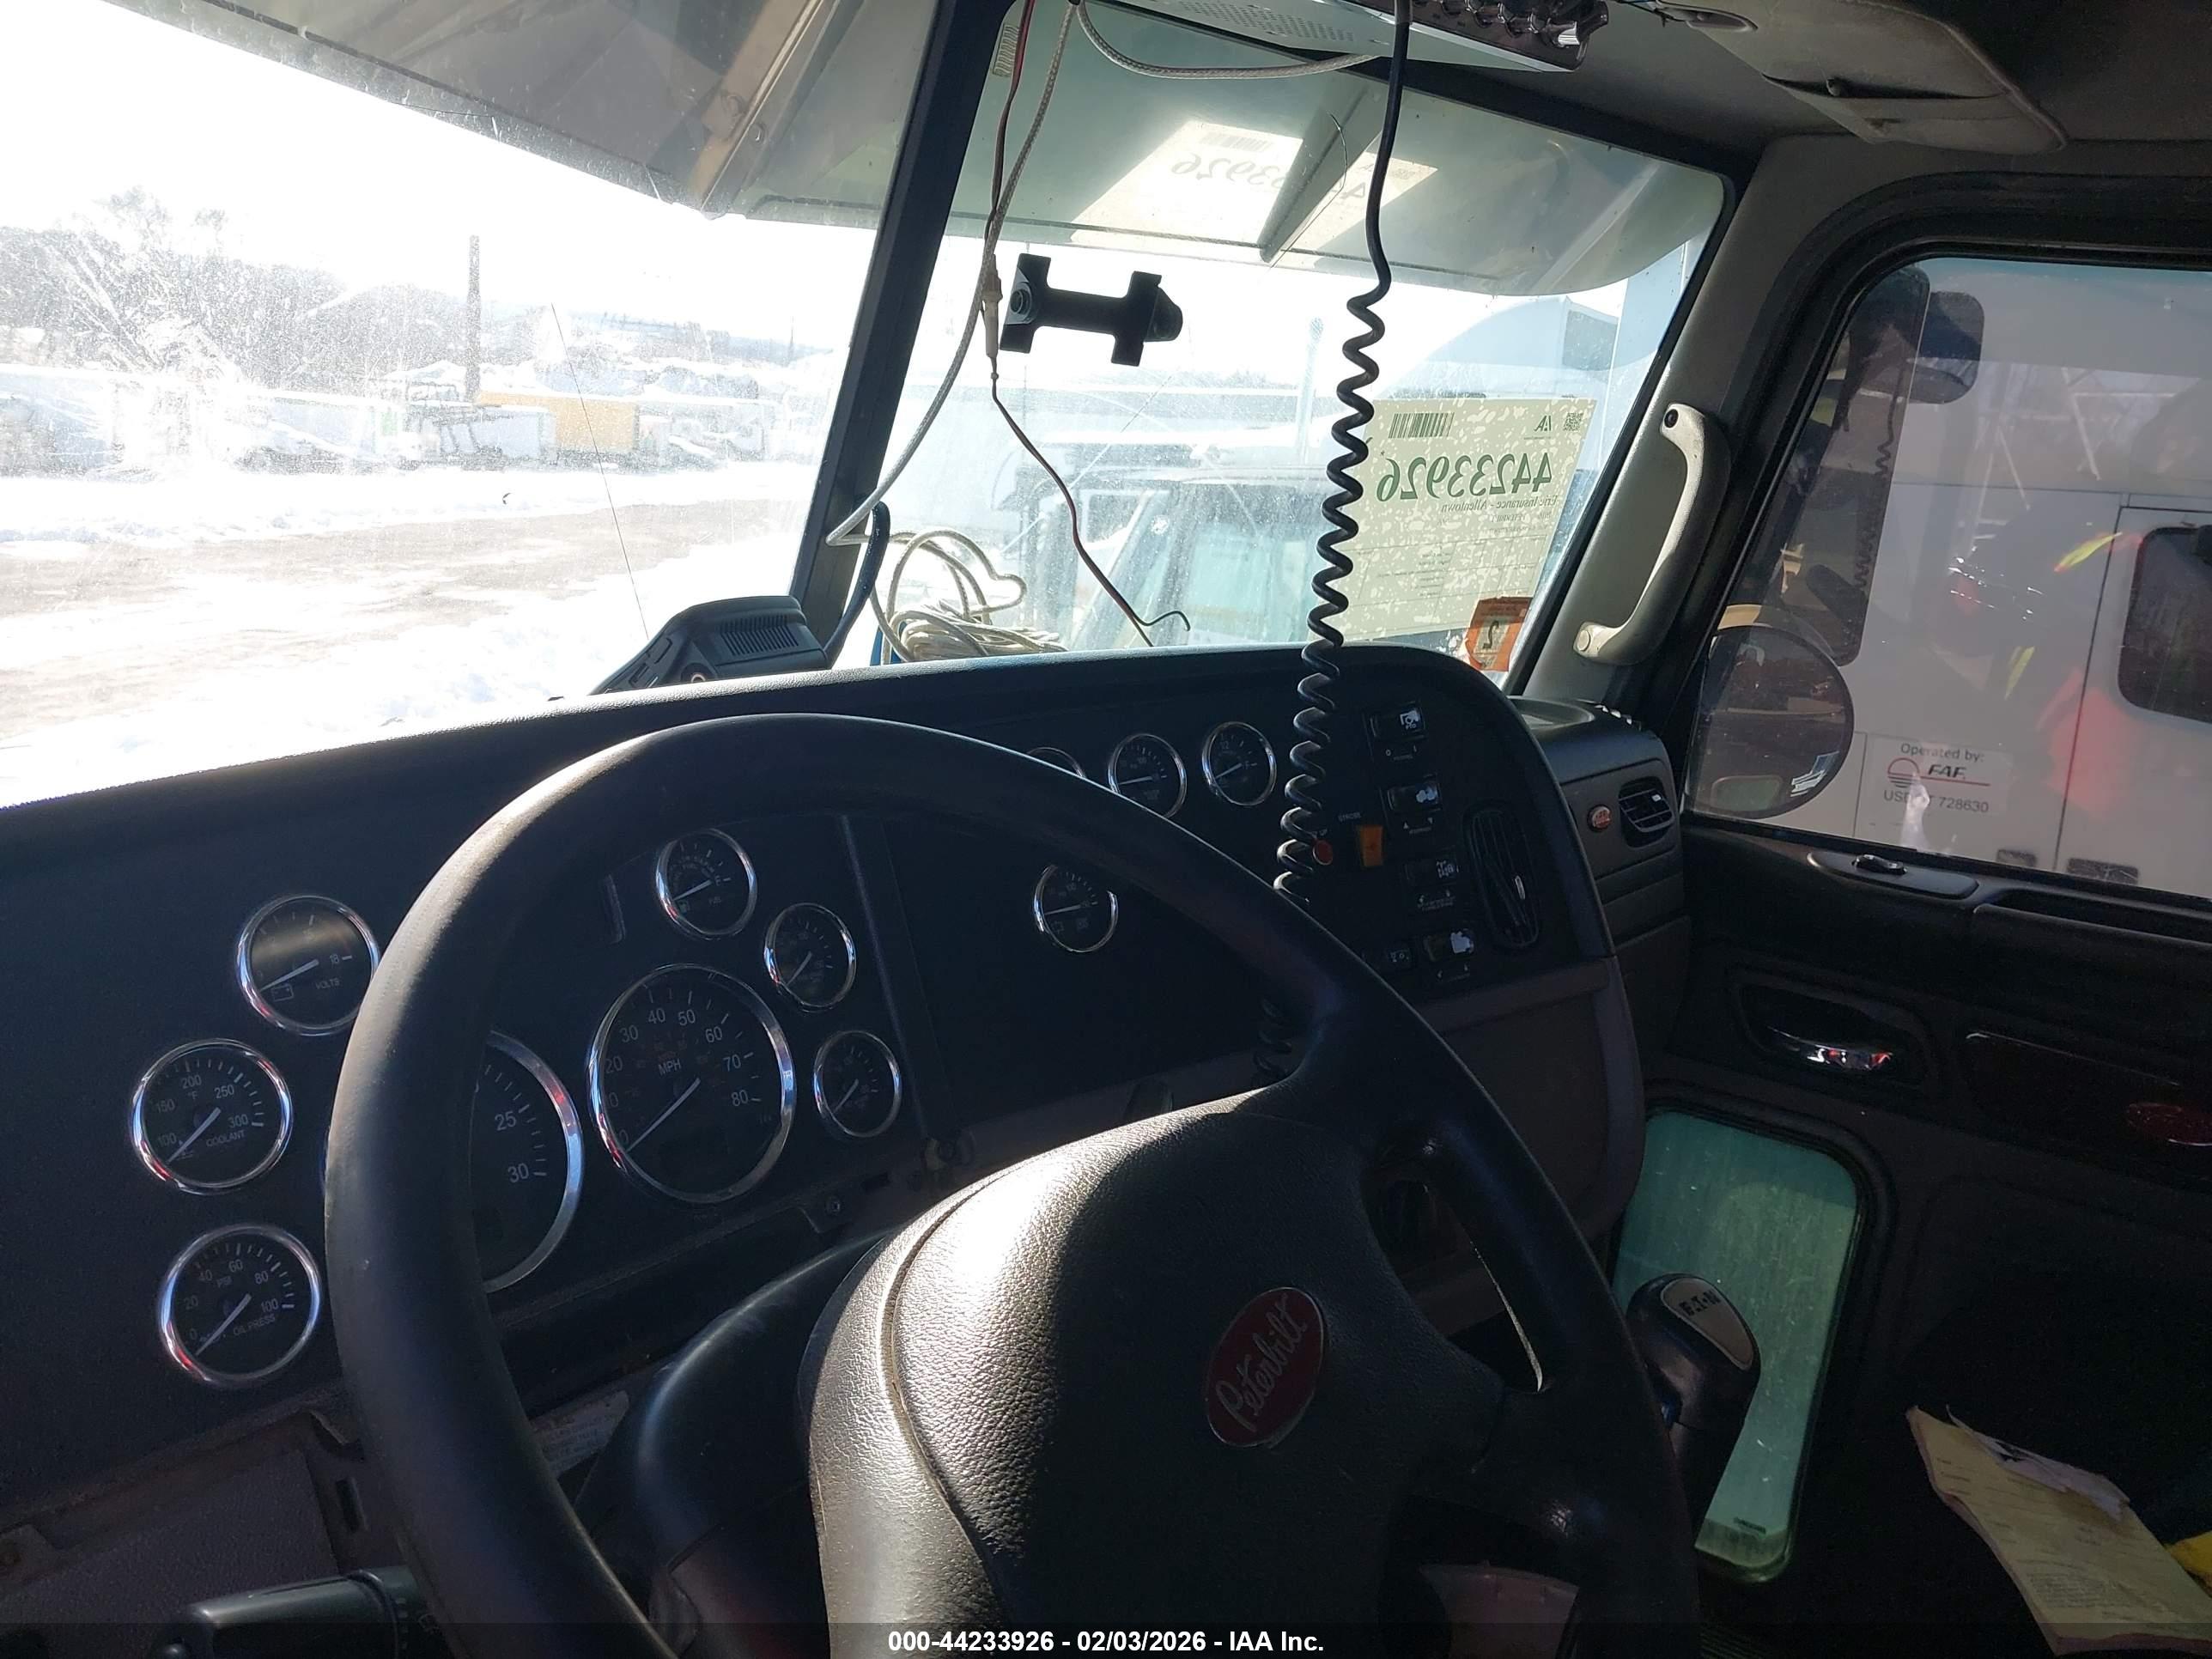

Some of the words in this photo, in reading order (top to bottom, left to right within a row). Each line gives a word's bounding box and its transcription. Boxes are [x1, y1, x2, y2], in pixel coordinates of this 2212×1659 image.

[1900, 742, 1961, 760] Operated
[1964, 750, 1985, 763] by:
[1938, 797, 1990, 814] 728630
[314, 975, 341, 990] VOLTS
[647, 1006, 667, 1024] 40
[677, 1008, 697, 1027] 50
[618, 1024, 640, 1044] 30
[704, 1025, 724, 1043] 60
[604, 1054, 624, 1075] 20
[657, 1058, 682, 1077] MPH
[722, 1053, 743, 1073] 70
[182, 1074, 204, 1091] 200
[214, 1085, 235, 1100] 250
[730, 1088, 750, 1108] 80
[154, 1098, 176, 1114] 150
[227, 1113, 250, 1130] 300
[494, 1110, 517, 1132] 25
[155, 1132, 178, 1148] 100
[205, 1128, 246, 1148] COOLANT
[507, 1162, 530, 1184] 30
[228, 1258, 245, 1273] 60
[198, 1268, 214, 1282] 40
[253, 1269, 270, 1285] 80
[183, 1294, 200, 1311] 20
[260, 1297, 280, 1315] 100
[247, 1312, 276, 1331] PRESS
[1215, 1292, 1308, 1432] Peterbilt
